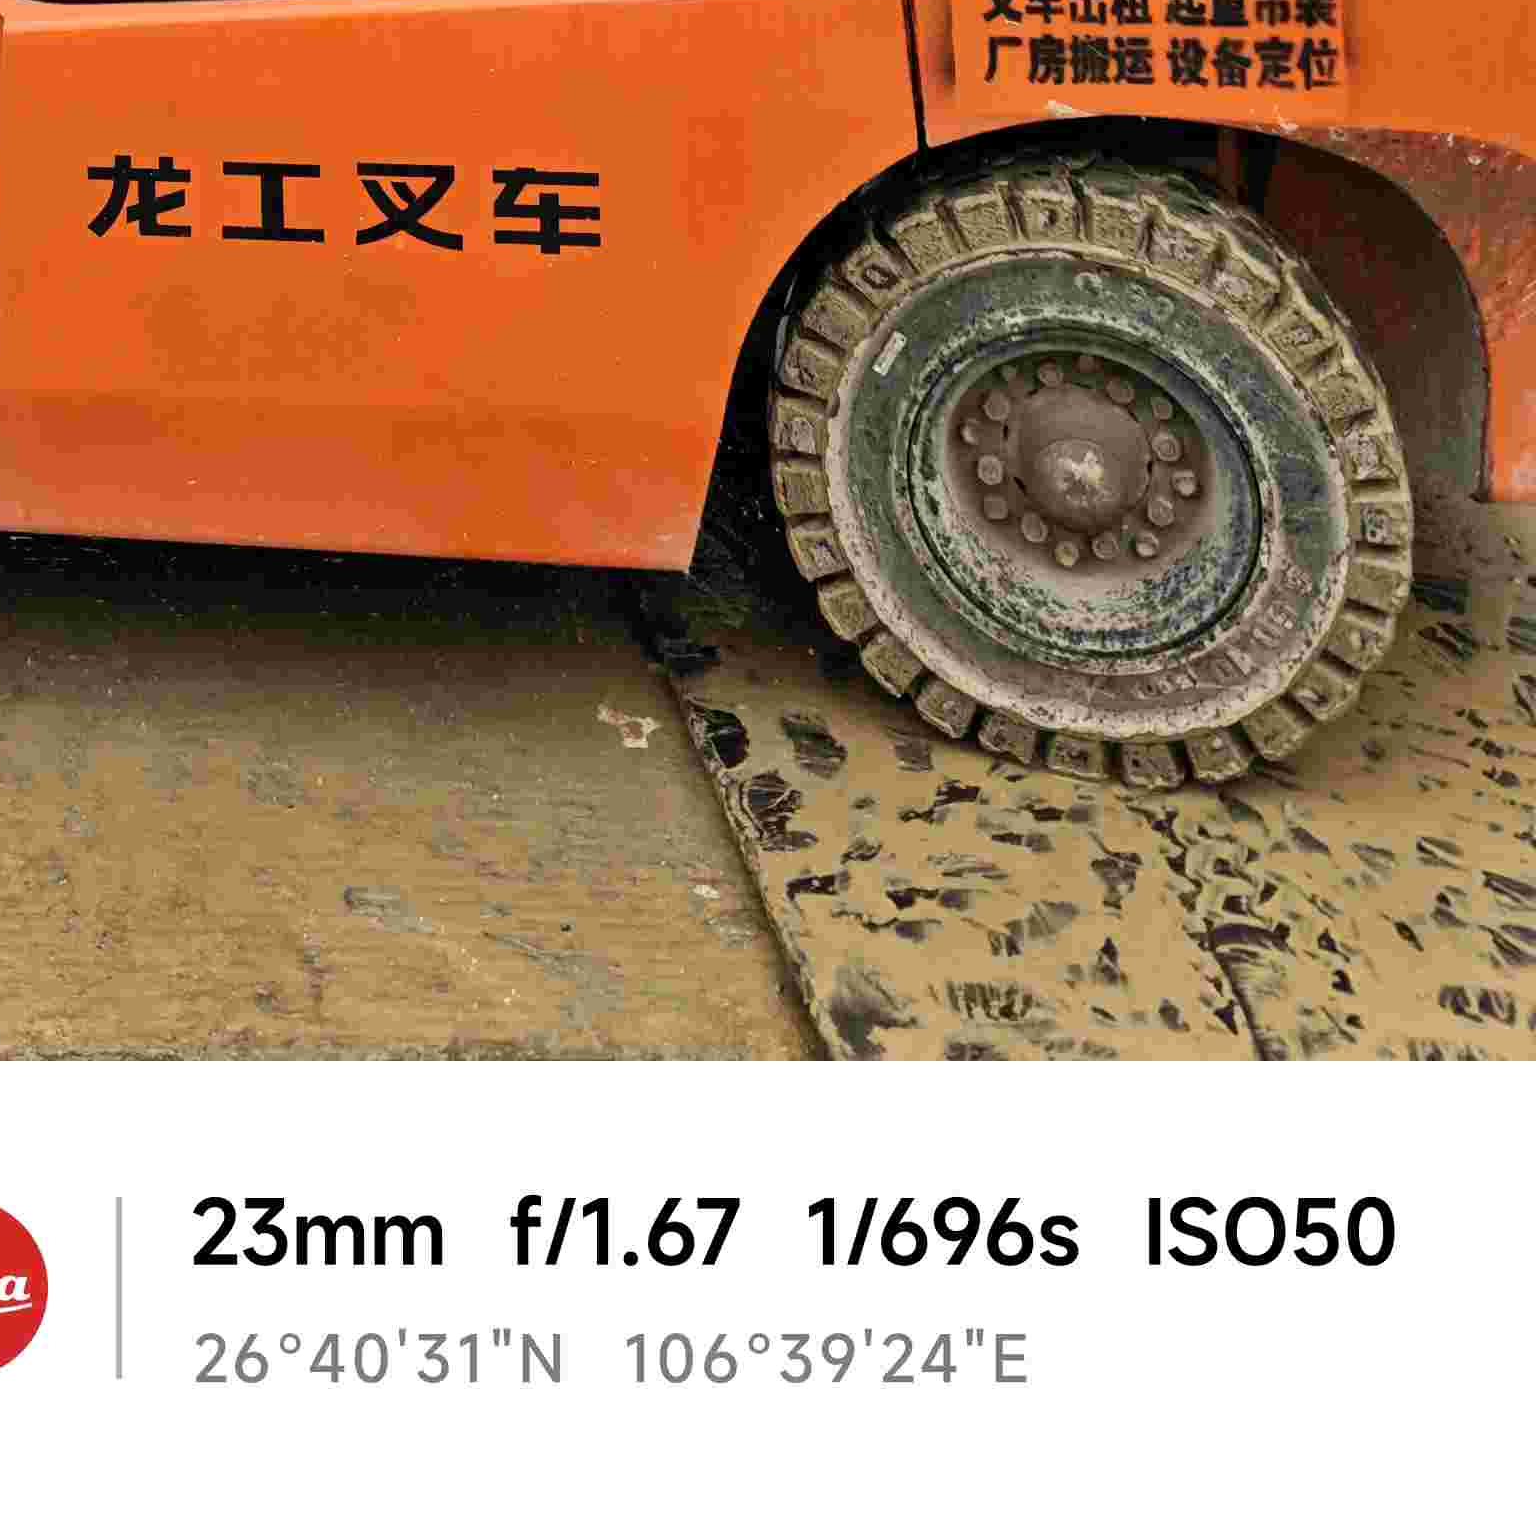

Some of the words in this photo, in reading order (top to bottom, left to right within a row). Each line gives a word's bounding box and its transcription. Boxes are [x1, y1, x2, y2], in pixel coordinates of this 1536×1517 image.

[983, 34, 1155, 86] 厂房搬运
[1166, 37, 1340, 91] 设备定位
[87, 155, 601, 255] 龙工叉车
